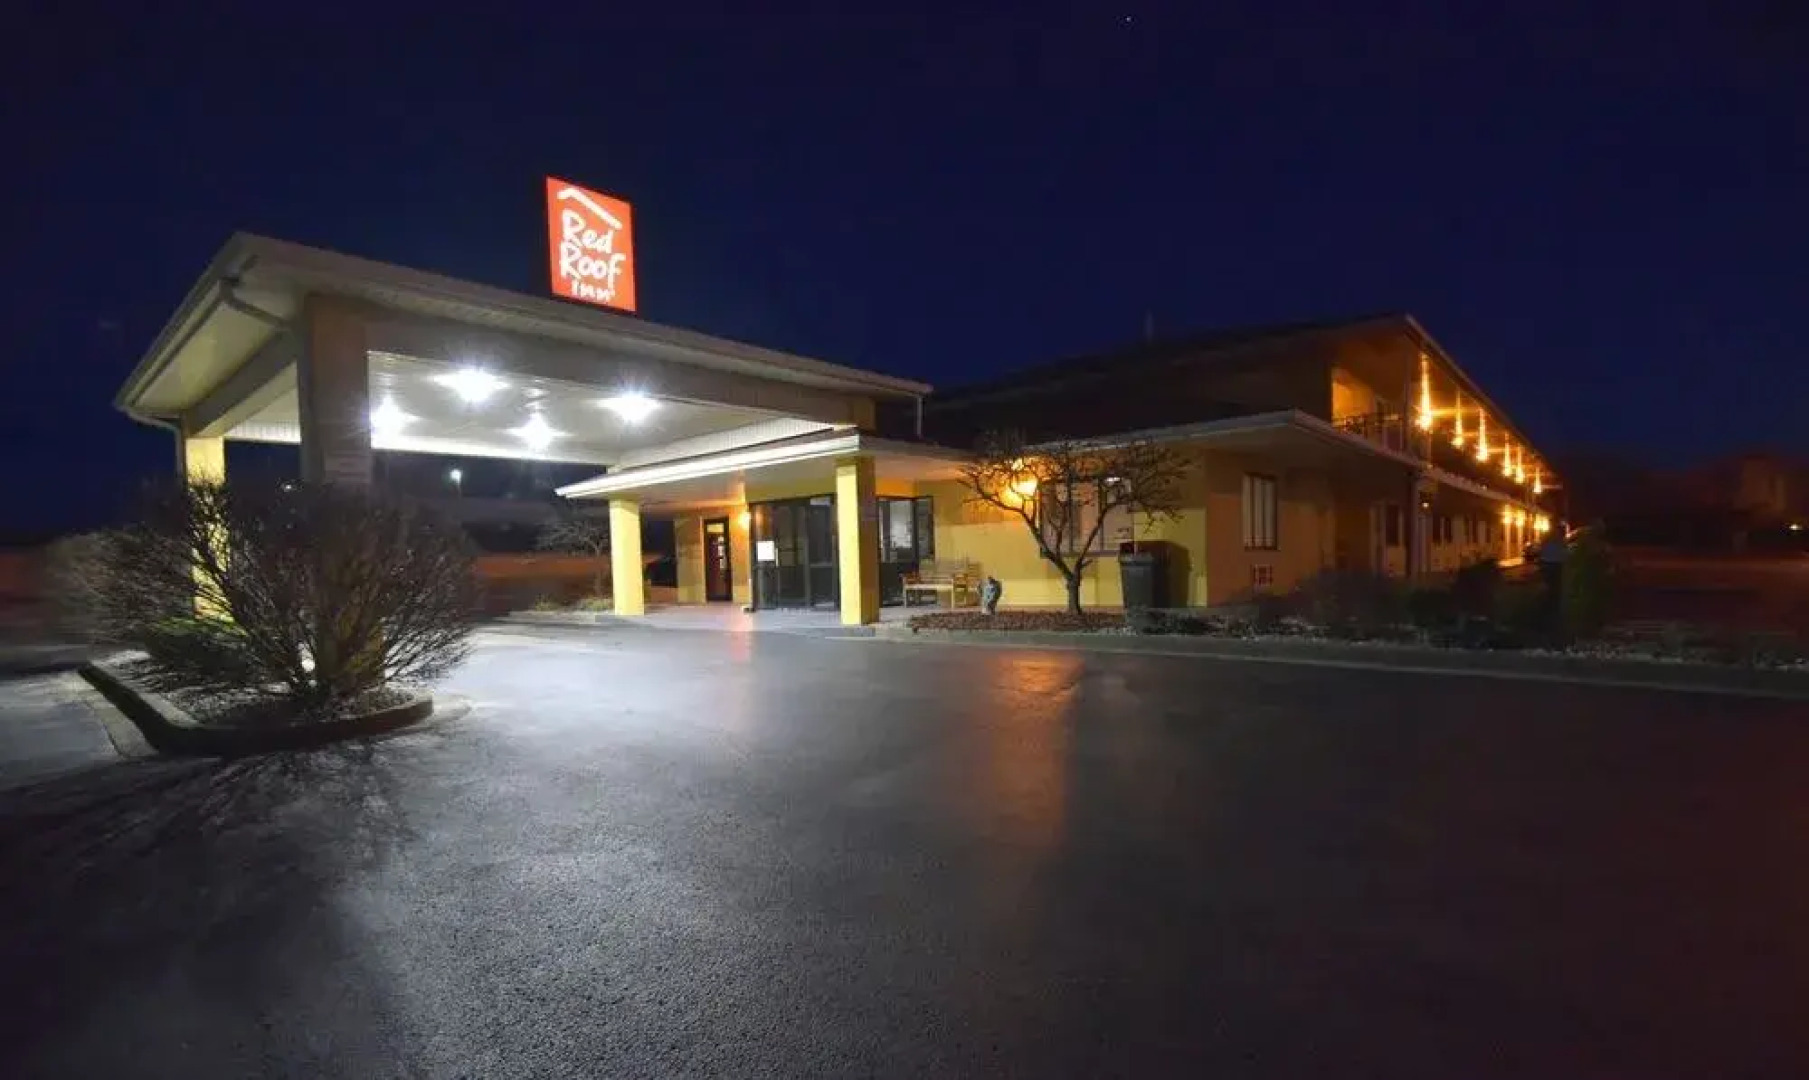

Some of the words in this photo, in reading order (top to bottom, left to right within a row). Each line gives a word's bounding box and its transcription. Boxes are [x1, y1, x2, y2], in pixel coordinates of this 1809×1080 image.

[562, 209, 613, 254] Red
[560, 241, 626, 290] Roof
[572, 279, 615, 301] Inn
